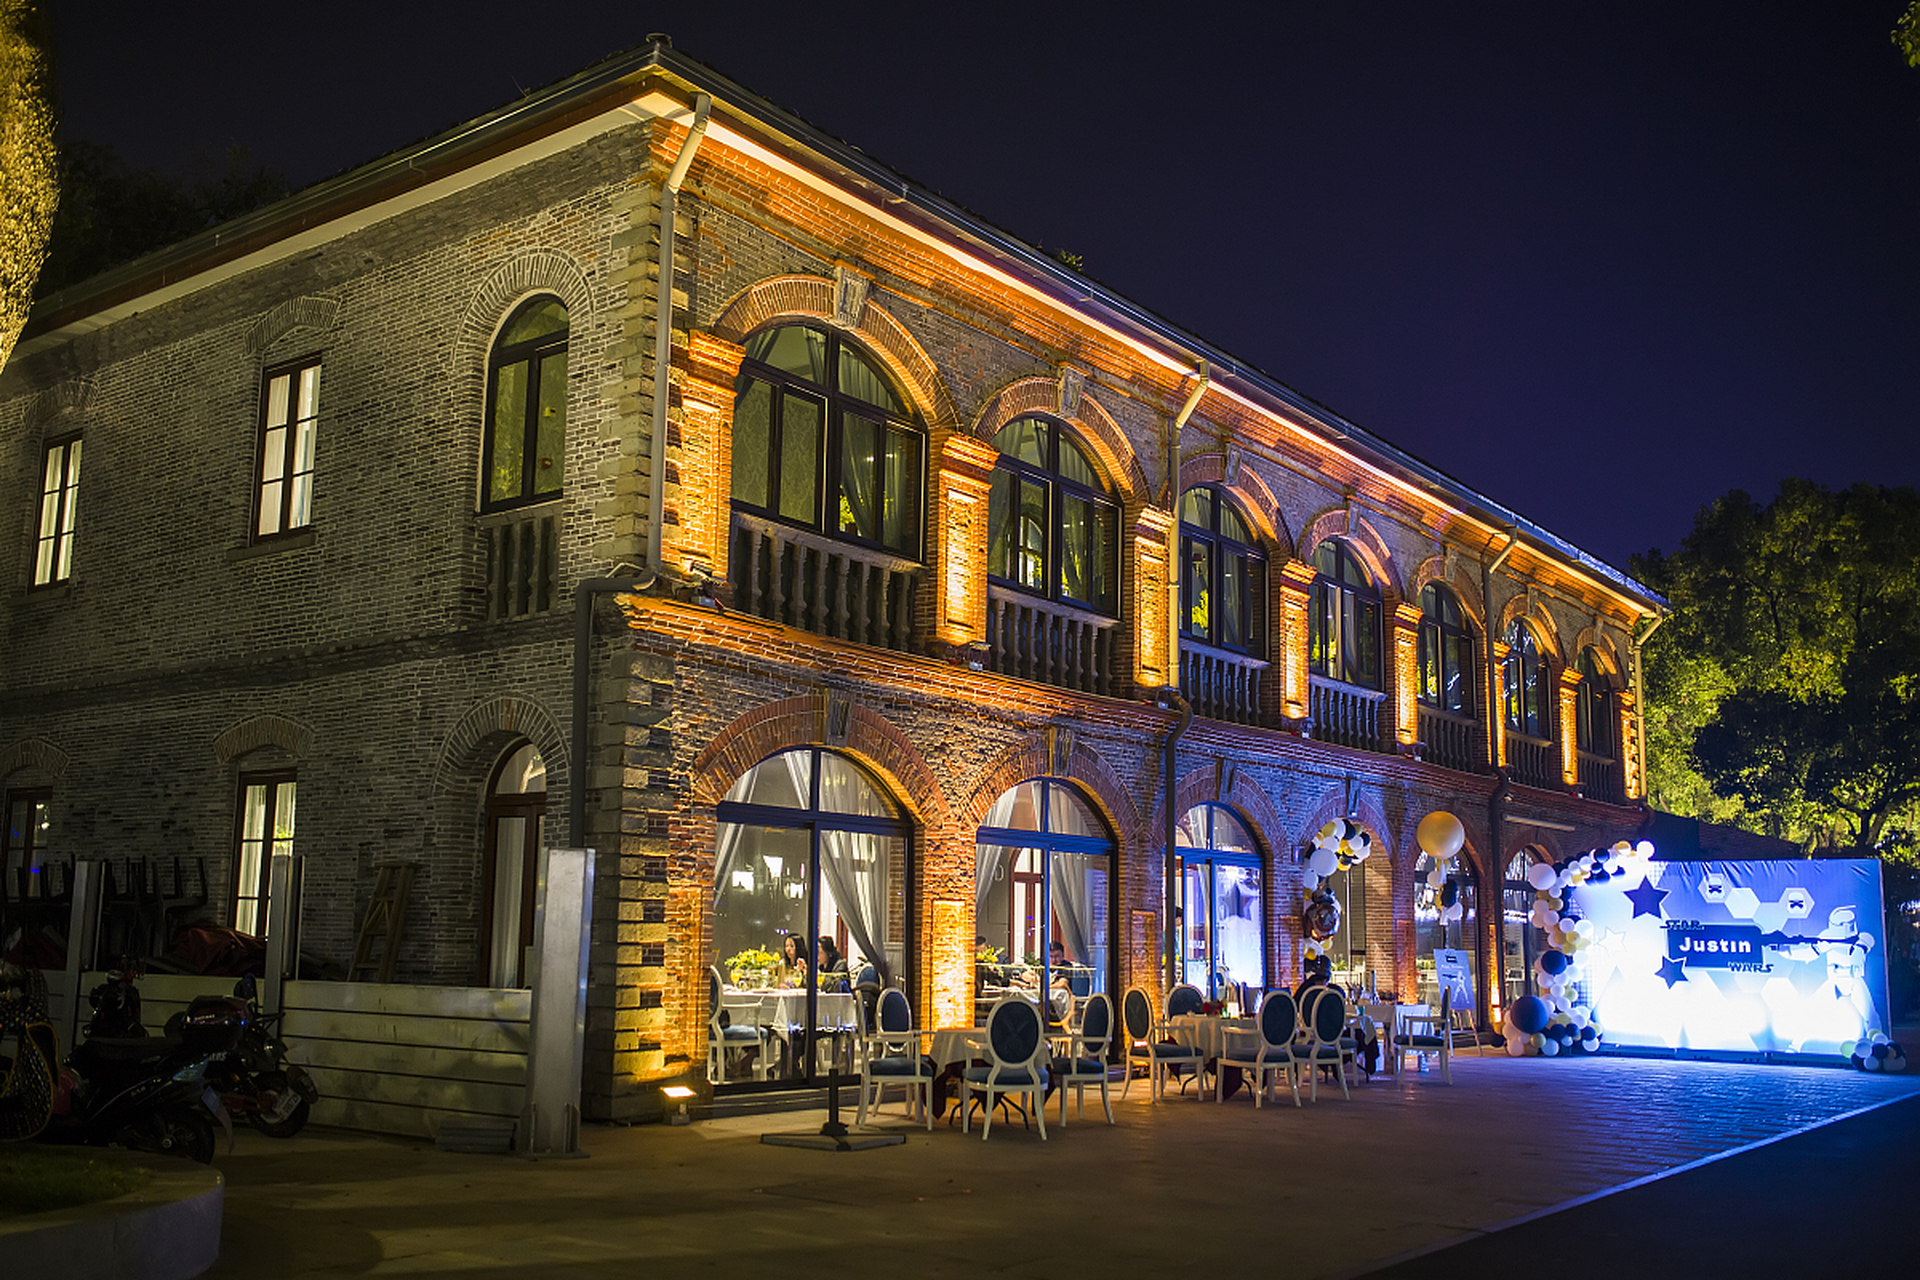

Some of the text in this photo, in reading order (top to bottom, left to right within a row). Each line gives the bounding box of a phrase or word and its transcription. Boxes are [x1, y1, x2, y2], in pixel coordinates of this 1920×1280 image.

[1660, 920, 1705, 931] STAR
[1679, 937, 1751, 953] Justin
[1728, 962, 1774, 973] WARS
